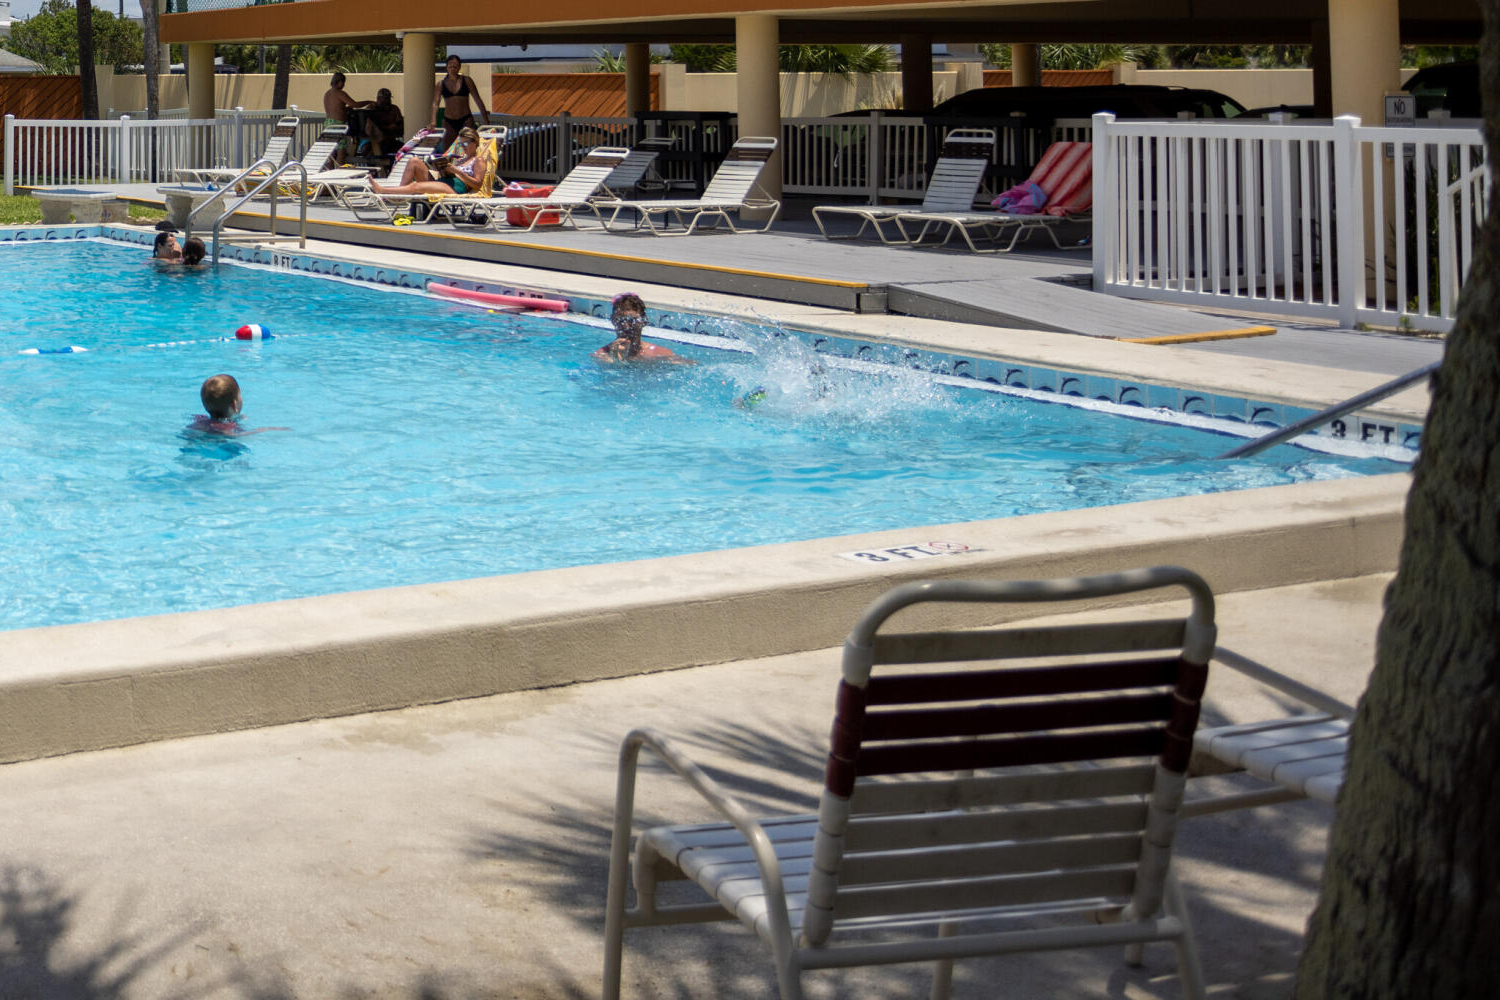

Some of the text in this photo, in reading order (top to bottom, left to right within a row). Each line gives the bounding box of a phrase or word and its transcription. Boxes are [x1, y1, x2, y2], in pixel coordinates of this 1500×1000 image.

[1394, 101, 1406, 115] NO
[281, 255, 290, 268] FT
[1331, 419, 1396, 444] 3 FT
[854, 551, 890, 562] 3
[884, 545, 942, 559] FT
